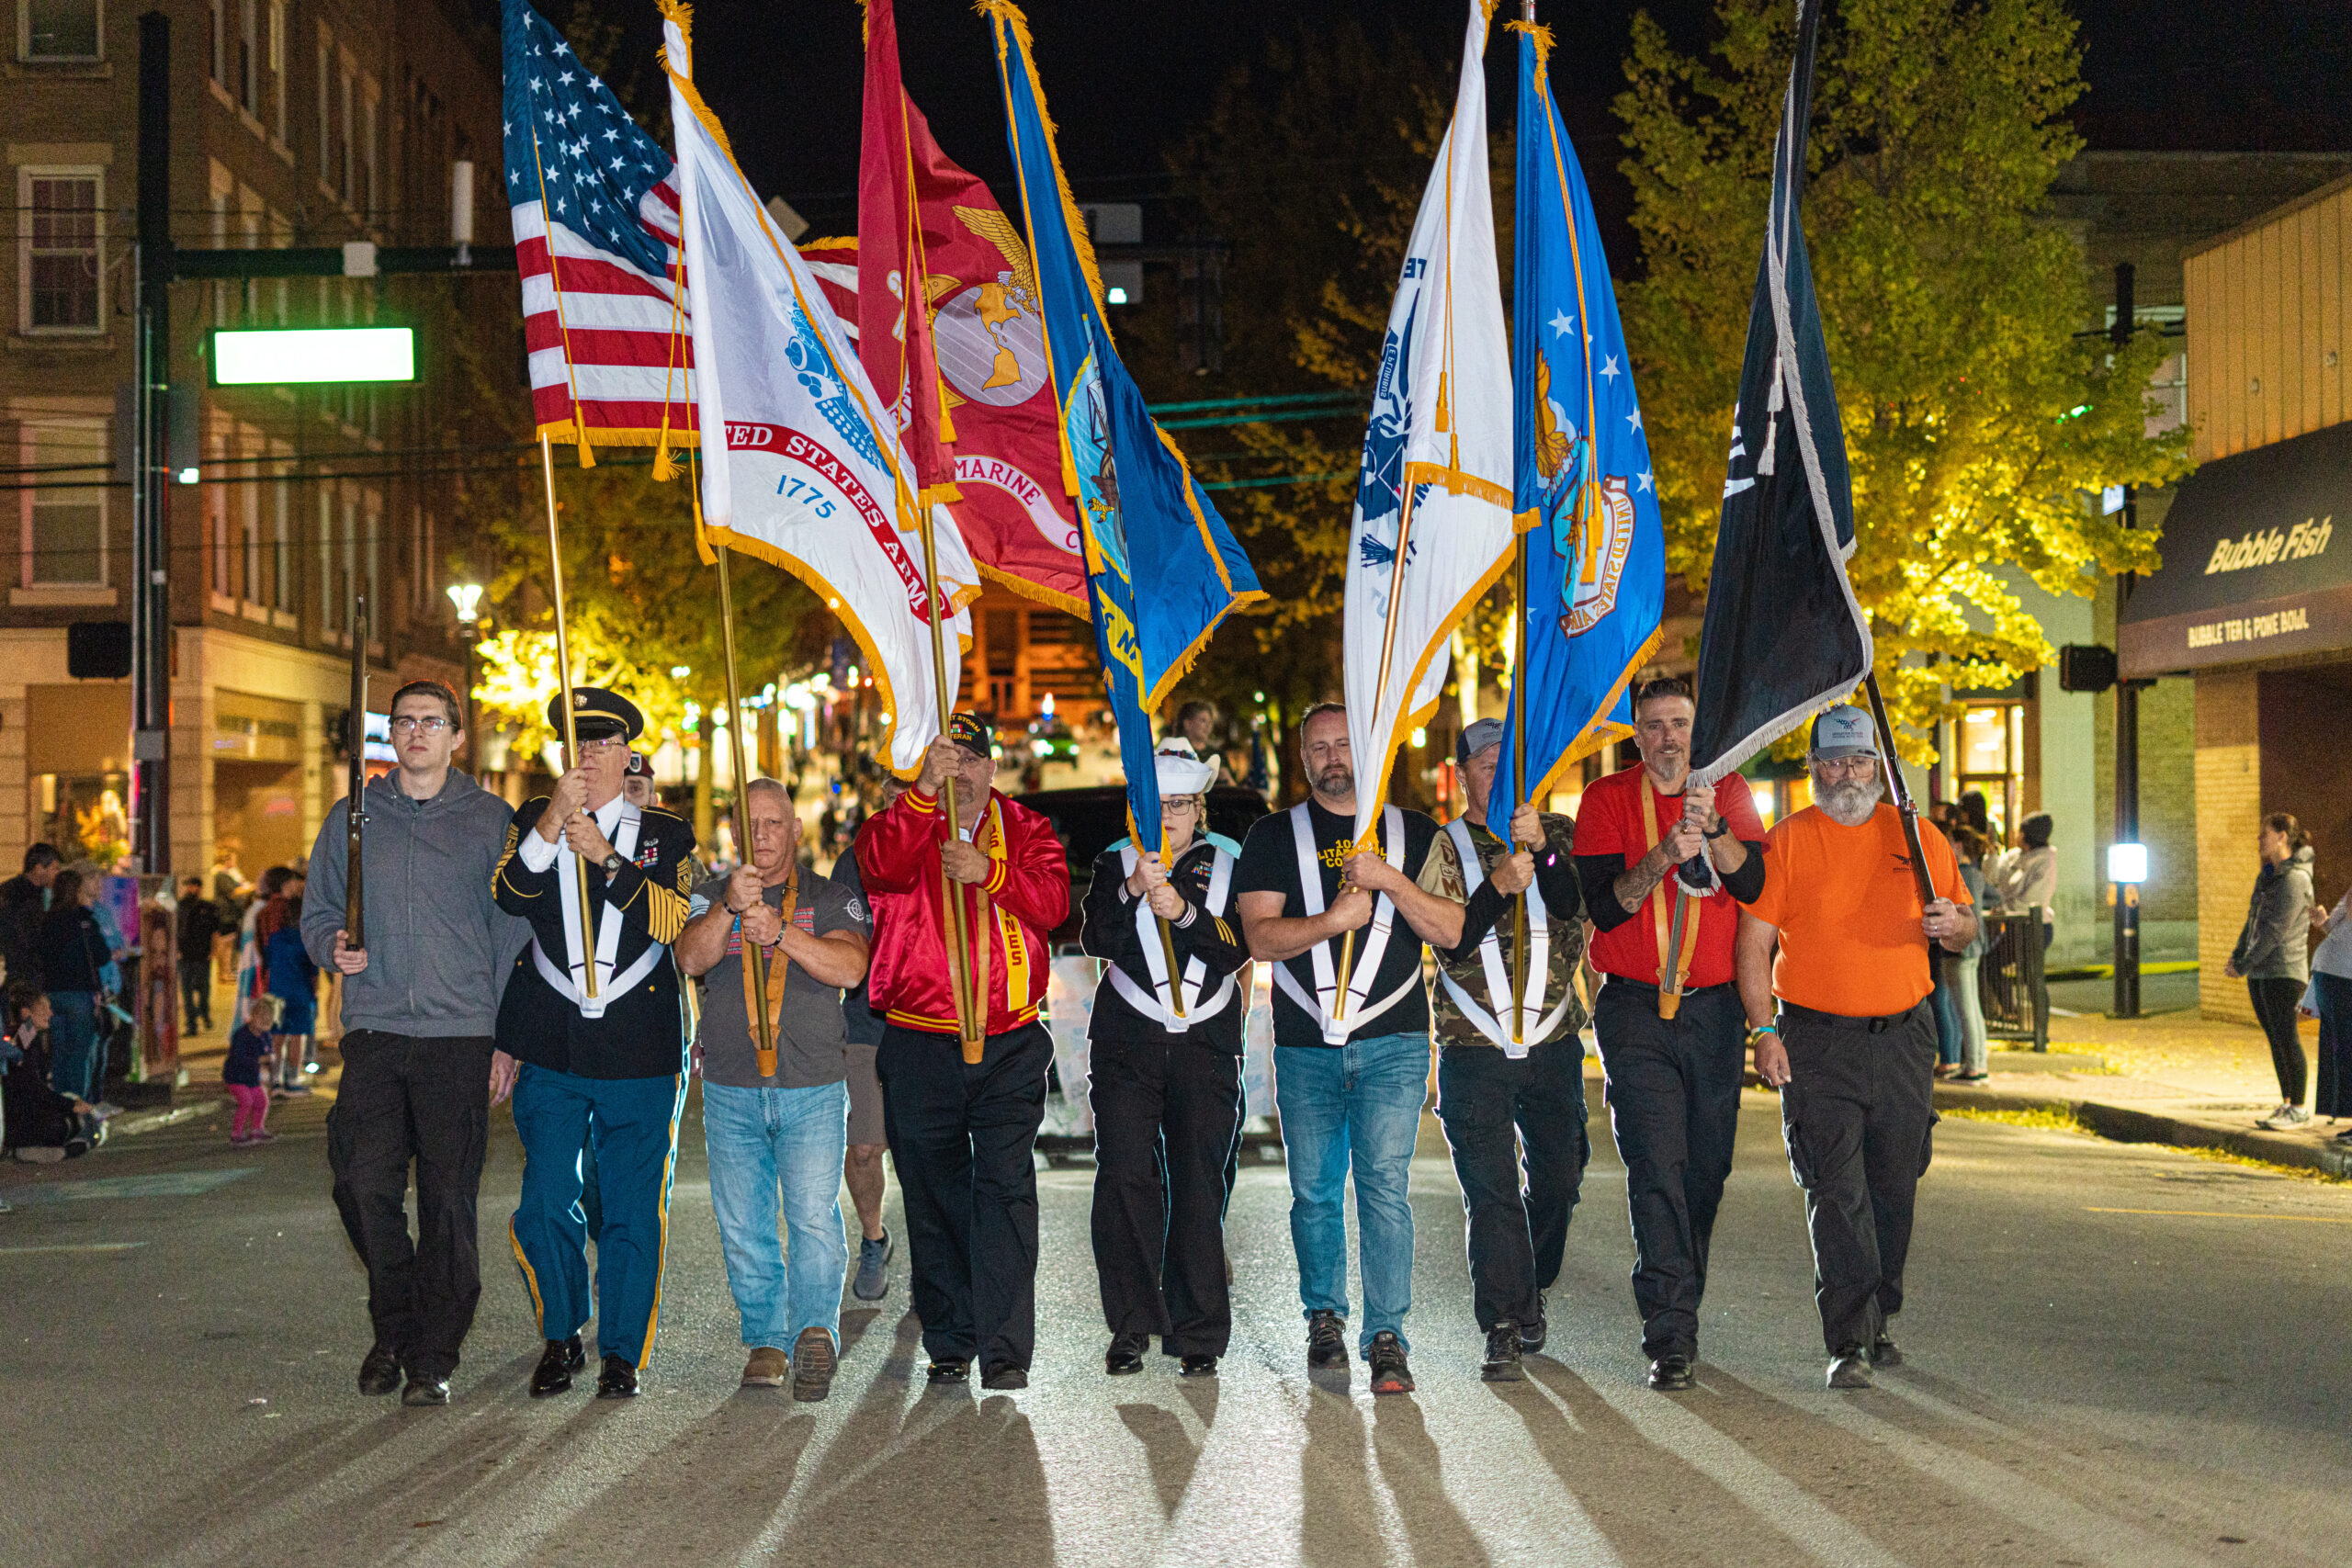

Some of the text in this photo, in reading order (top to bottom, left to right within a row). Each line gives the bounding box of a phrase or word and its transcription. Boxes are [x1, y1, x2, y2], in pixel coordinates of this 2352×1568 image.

[776, 474, 837, 519] 1775
[786, 435, 885, 528] STATES
[955, 458, 1041, 506] MARINE
[2204, 515, 2333, 575] Bubble Fish
[2188, 622, 2223, 649] BUBBLE
[2224, 619, 2244, 642] TEA
[2253, 612, 2279, 638] POKE
[2280, 607, 2310, 634] BOWL
[957, 715, 981, 733] STORM
